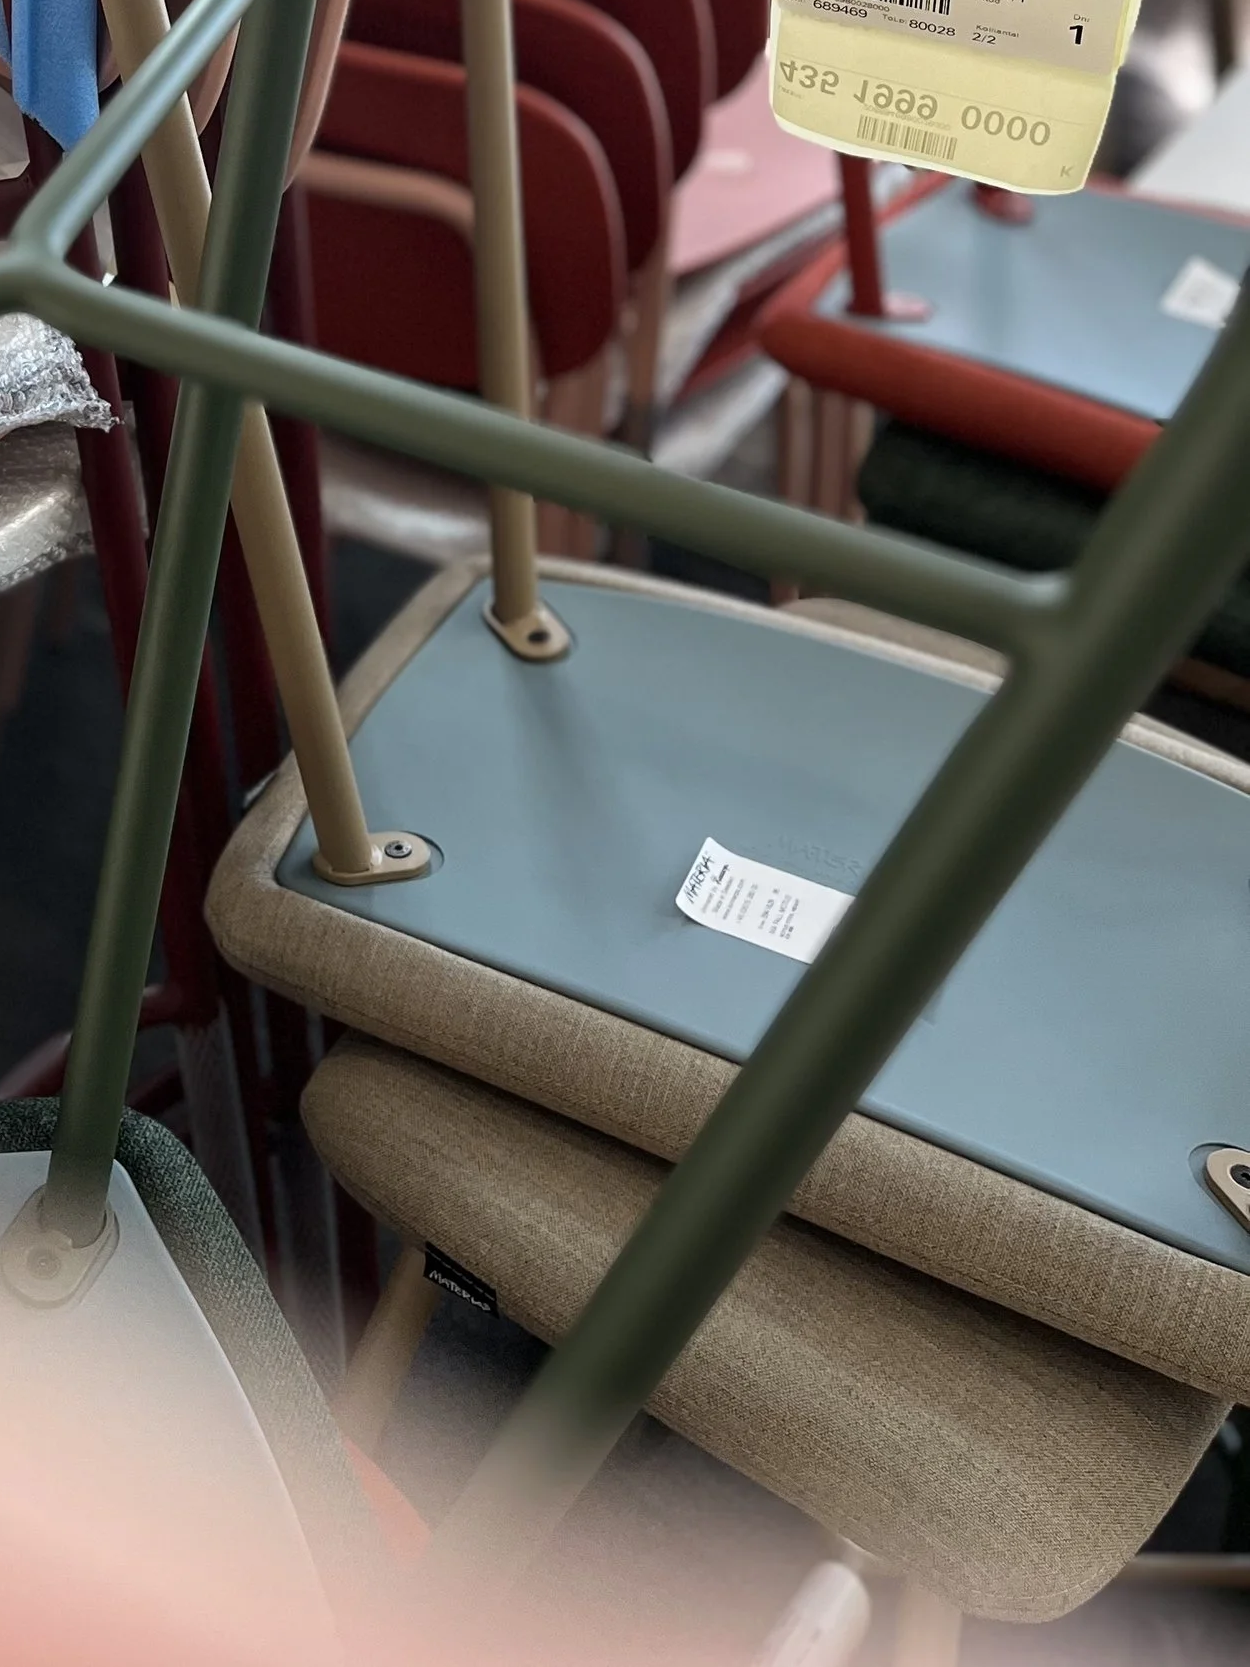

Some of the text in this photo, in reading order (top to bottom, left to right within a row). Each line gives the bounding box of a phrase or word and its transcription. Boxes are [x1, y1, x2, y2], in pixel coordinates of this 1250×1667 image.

[813, 0, 868, 19] 689469
[908, 19, 956, 37] 80028
[972, 32, 996, 45] 2/2
[1069, 25, 1084, 45] 1
[683, 854, 715, 904] MATERIA
